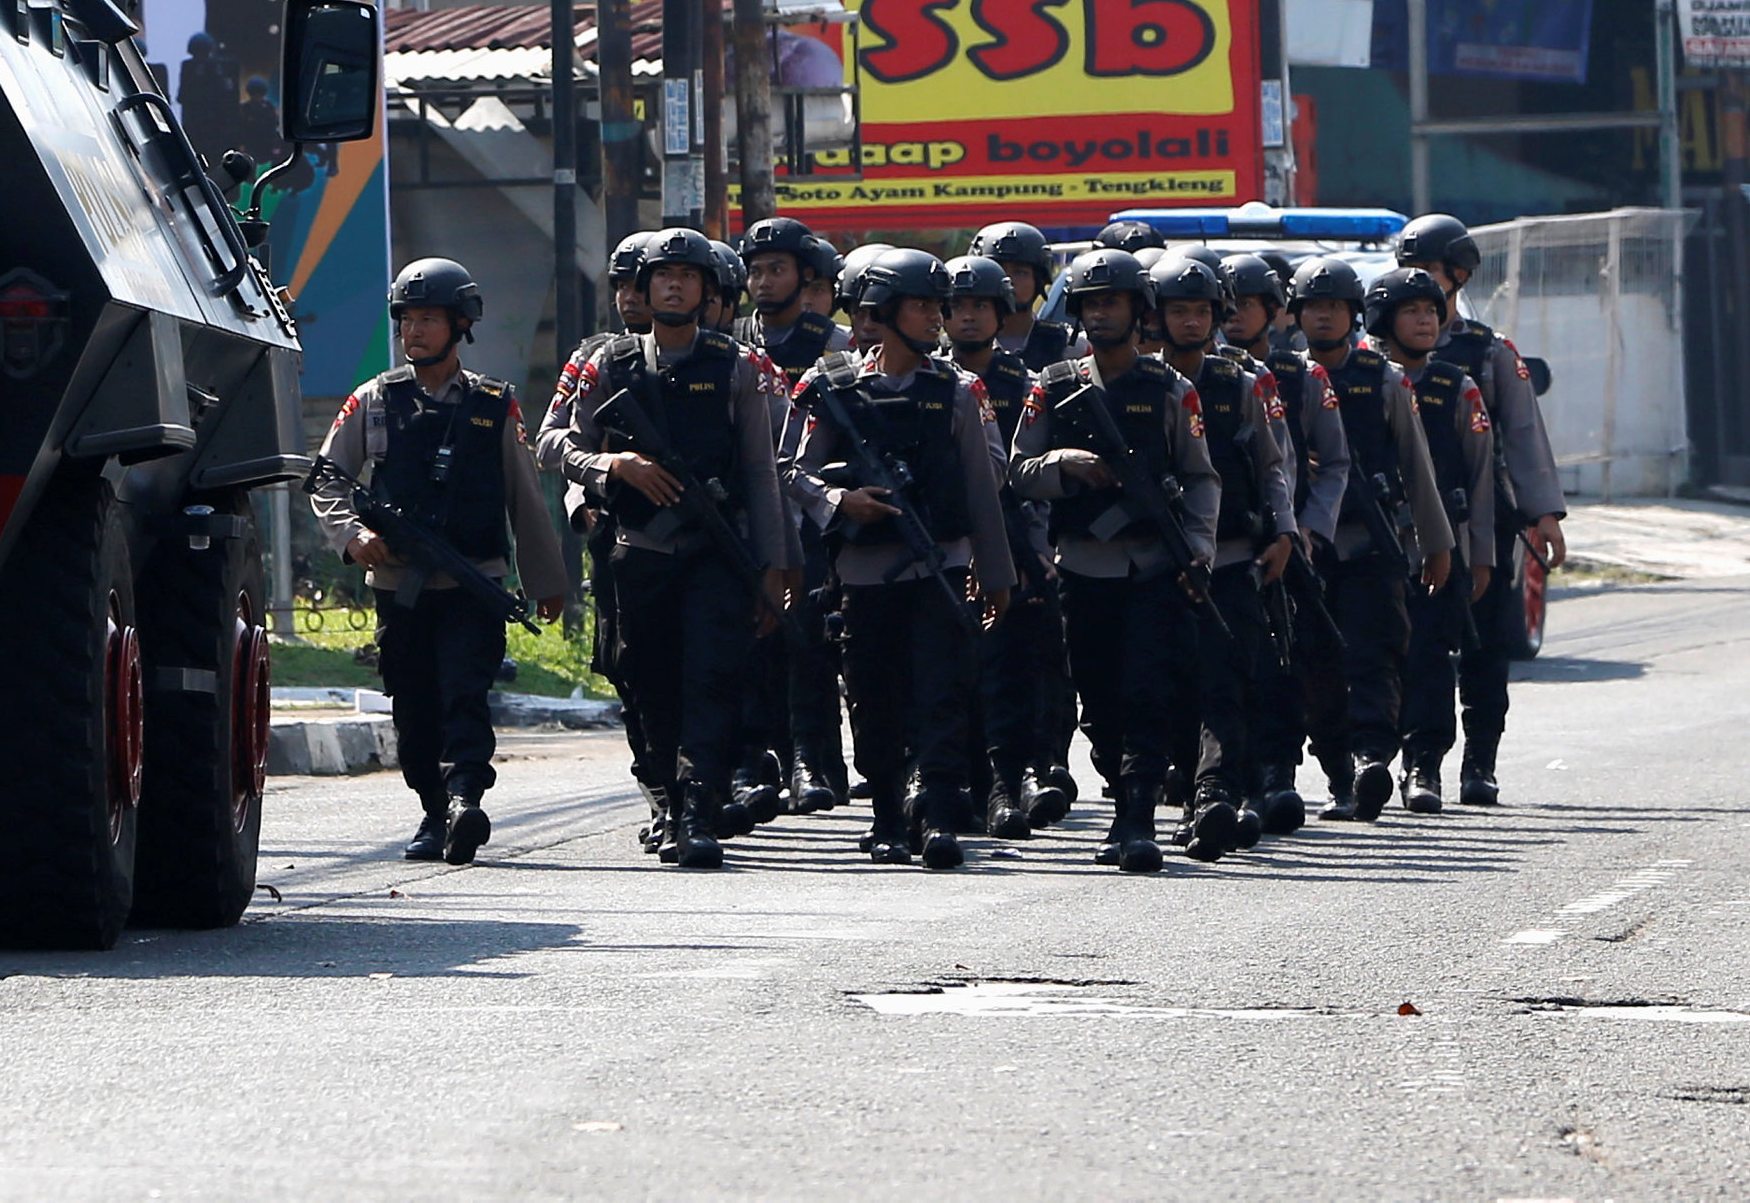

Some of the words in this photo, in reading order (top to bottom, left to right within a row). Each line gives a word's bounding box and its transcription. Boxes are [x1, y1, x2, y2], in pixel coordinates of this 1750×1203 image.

[987, 130, 1230, 167] boyolali
[781, 186, 841, 201] Soto
[850, 186, 926, 201] Ayam
[933, 182, 1063, 198] Kampung
[1084, 178, 1224, 194] Tengkleng
